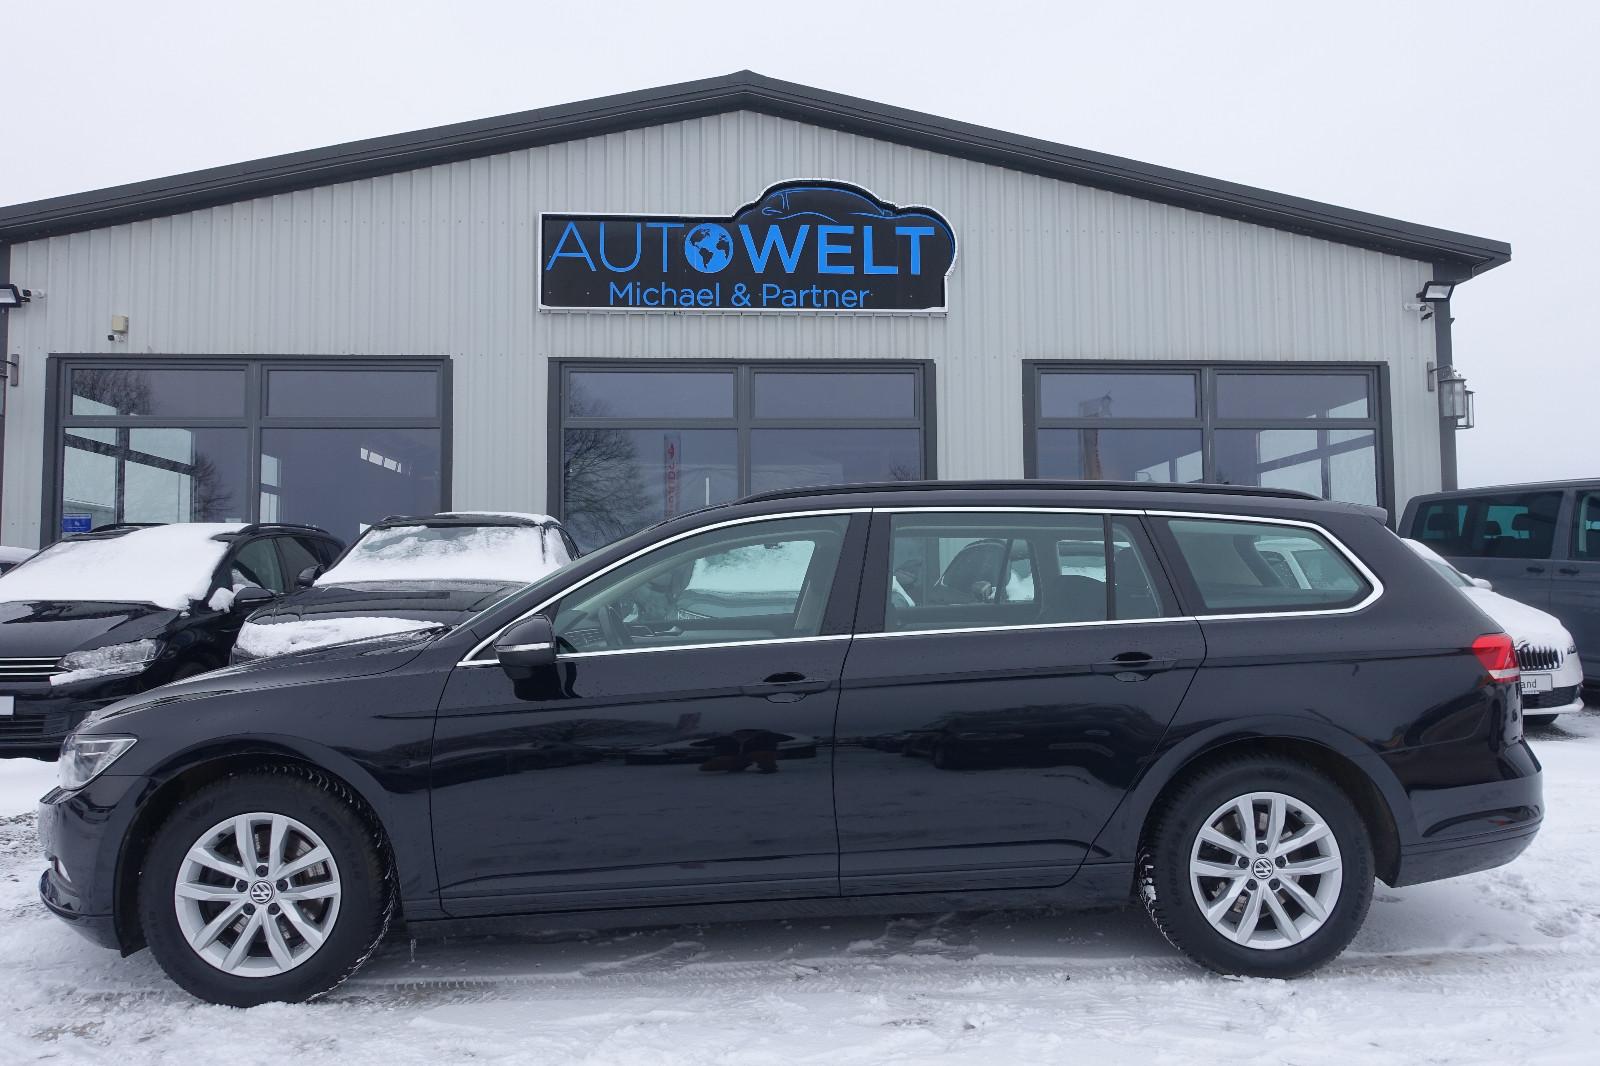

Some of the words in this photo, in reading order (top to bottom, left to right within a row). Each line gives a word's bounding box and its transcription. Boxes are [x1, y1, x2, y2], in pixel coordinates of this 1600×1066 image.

[609, 281, 720, 307] Michael
[730, 282, 751, 307] &
[762, 283, 870, 308] Partner
